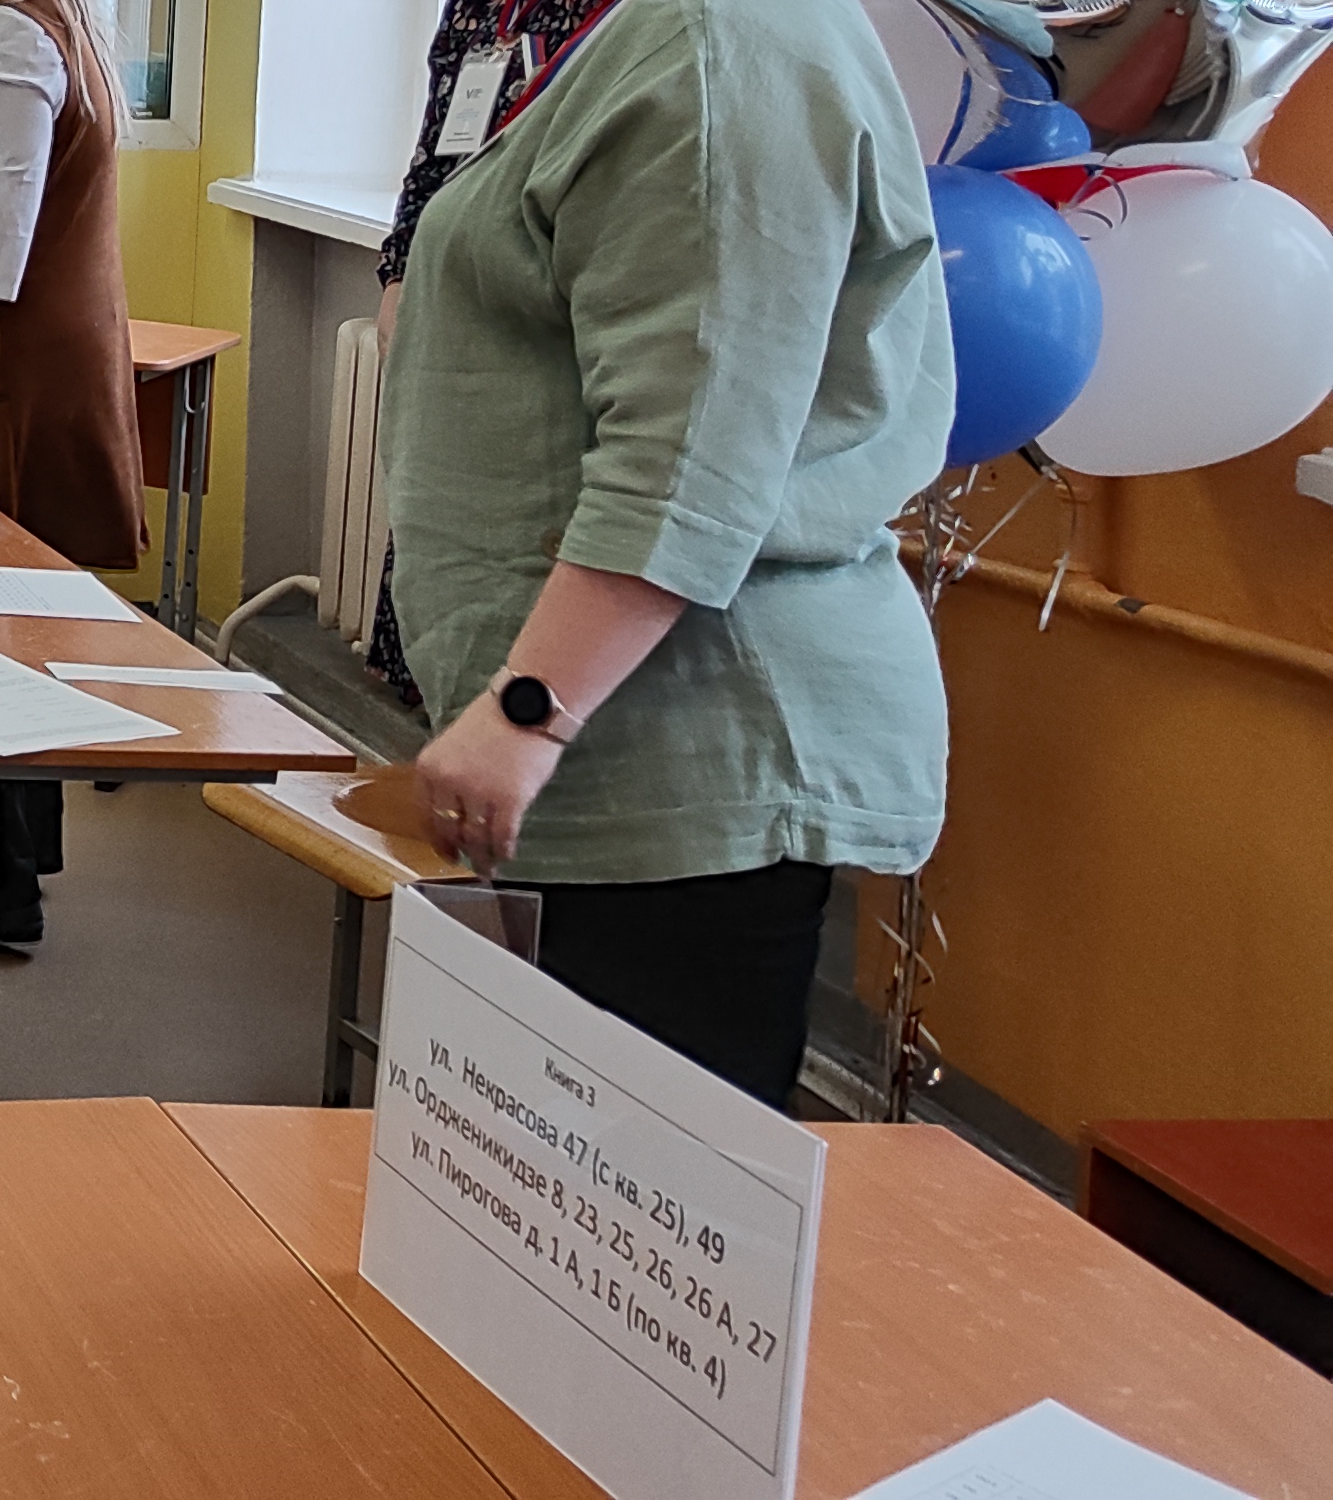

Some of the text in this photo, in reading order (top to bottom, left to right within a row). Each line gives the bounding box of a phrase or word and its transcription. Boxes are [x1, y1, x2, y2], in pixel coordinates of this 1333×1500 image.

[429, 1038, 725, 1264] ул. Некрасова 47 (с кв. 25), 49
[544, 1056, 596, 1107] Книга 3
[388, 1059, 410, 1094] ул.
[550, 1178, 567, 1219] 8,
[573, 1195, 602, 1246] 23,
[609, 1221, 639, 1272] 25,
[645, 1248, 677, 1300] 26,
[684, 1276, 712, 1319] 26
[746, 1321, 776, 1363] 27
[411, 1131, 434, 1166] ул.
[438, 1147, 521, 1234] Пирогова
[524, 1225, 543, 1257] д.
[549, 1236, 560, 1267] 1
[590, 1268, 601, 1300] 1
[607, 1279, 622, 1312] Б
[626, 1292, 661, 1342] (по
[666, 1329, 697, 1373] кв.
[703, 1355, 726, 1400] 4)
